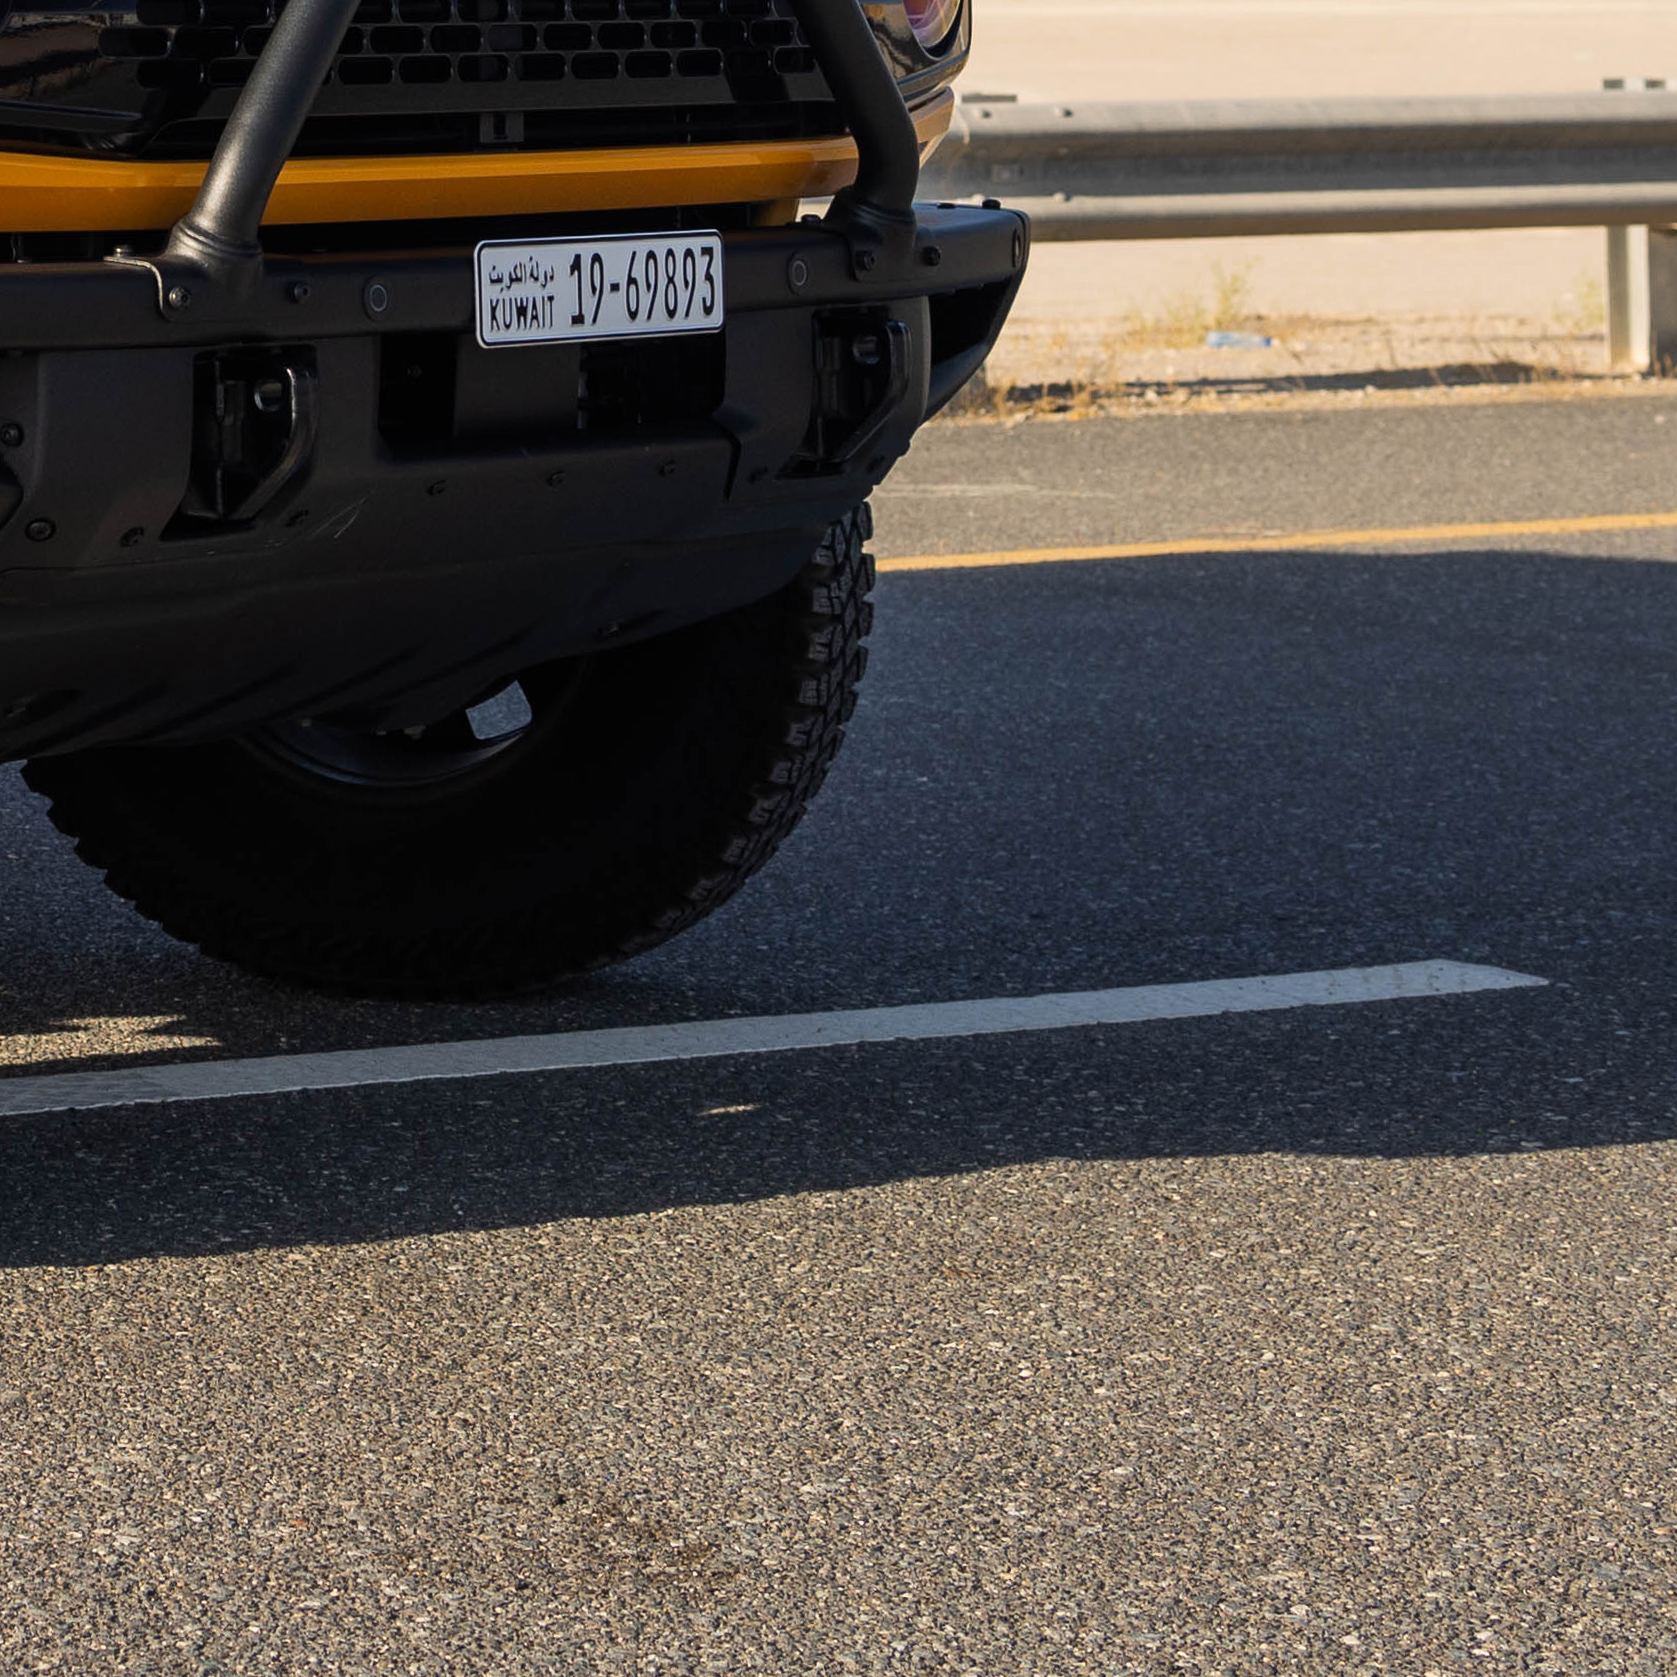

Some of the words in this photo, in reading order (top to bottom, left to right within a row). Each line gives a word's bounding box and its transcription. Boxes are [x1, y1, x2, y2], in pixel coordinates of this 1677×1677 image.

[489, 261, 528, 292] الكويت
[529, 256, 556, 289] دولة
[568, 245, 716, 325] 19-69893
[489, 294, 556, 332] KUWAIT
